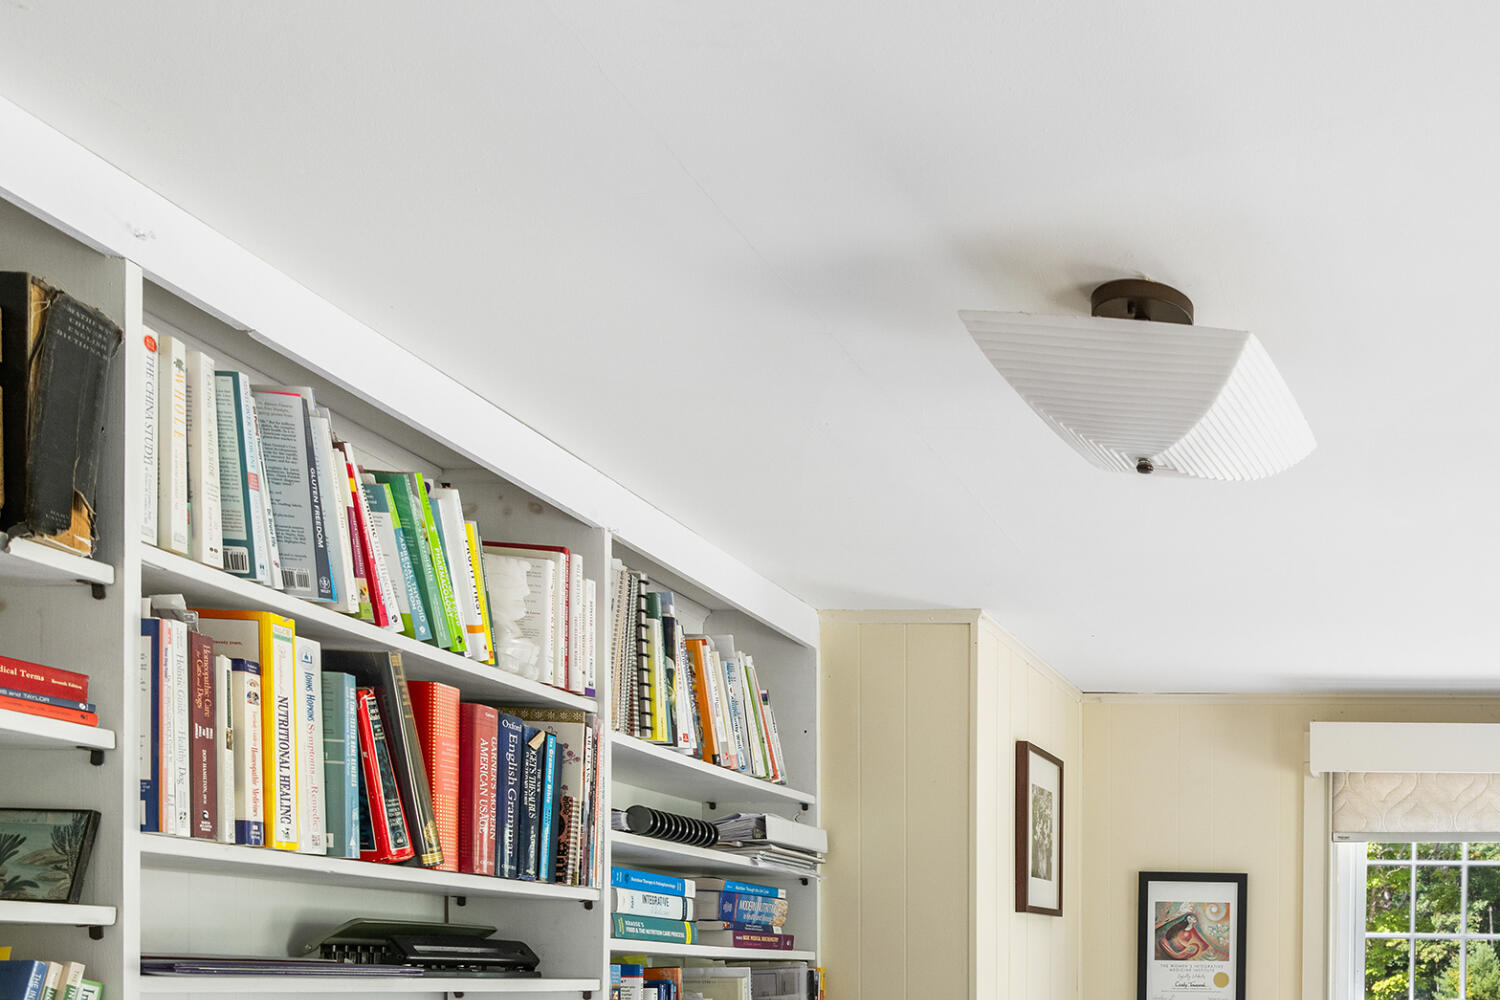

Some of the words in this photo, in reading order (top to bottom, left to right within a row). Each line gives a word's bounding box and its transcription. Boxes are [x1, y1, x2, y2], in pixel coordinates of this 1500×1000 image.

[146, 354, 156, 378] THE
[145, 380, 156, 419] CHINA
[174, 371, 185, 442] WHOLE
[310, 467, 319, 502] GLUTEN
[313, 504, 325, 549] FREEDOM
[399, 533, 415, 579] ADRENAL
[410, 580, 426, 623] THYROID
[403, 551, 418, 612] REVOLUTION
[434, 547, 454, 617] PHARMACOLOGY
[20, 668, 45, 682] Terms
[175, 653, 186, 687] Holistic
[201, 643, 213, 696] Homeopathic
[303, 671, 315, 693] JOHNS
[194, 687, 205, 710] Dogs
[203, 697, 213, 719] Care
[304, 694, 316, 722] HOPKINS
[176, 729, 187, 764] Healthy
[277, 695, 292, 775] NUTRITIONAL
[305, 723, 317, 776] Symptoms
[176, 766, 188, 786] Dog
[351, 758, 359, 787] REMEDIES
[479, 737, 489, 796] AMERICAN
[489, 736, 498, 790] GARNER'S
[505, 732, 518, 785] English
[547, 748, 555, 783] Grammar
[280, 777, 293, 826] HEALING
[478, 798, 489, 834] USAGE
[488, 792, 497, 840] MODERN
[527, 780, 537, 819] THESAURUS
[506, 787, 518, 857] Grammar
[641, 894, 671, 907] INTEGRATIVE
[31, 973, 43, 989] THE
